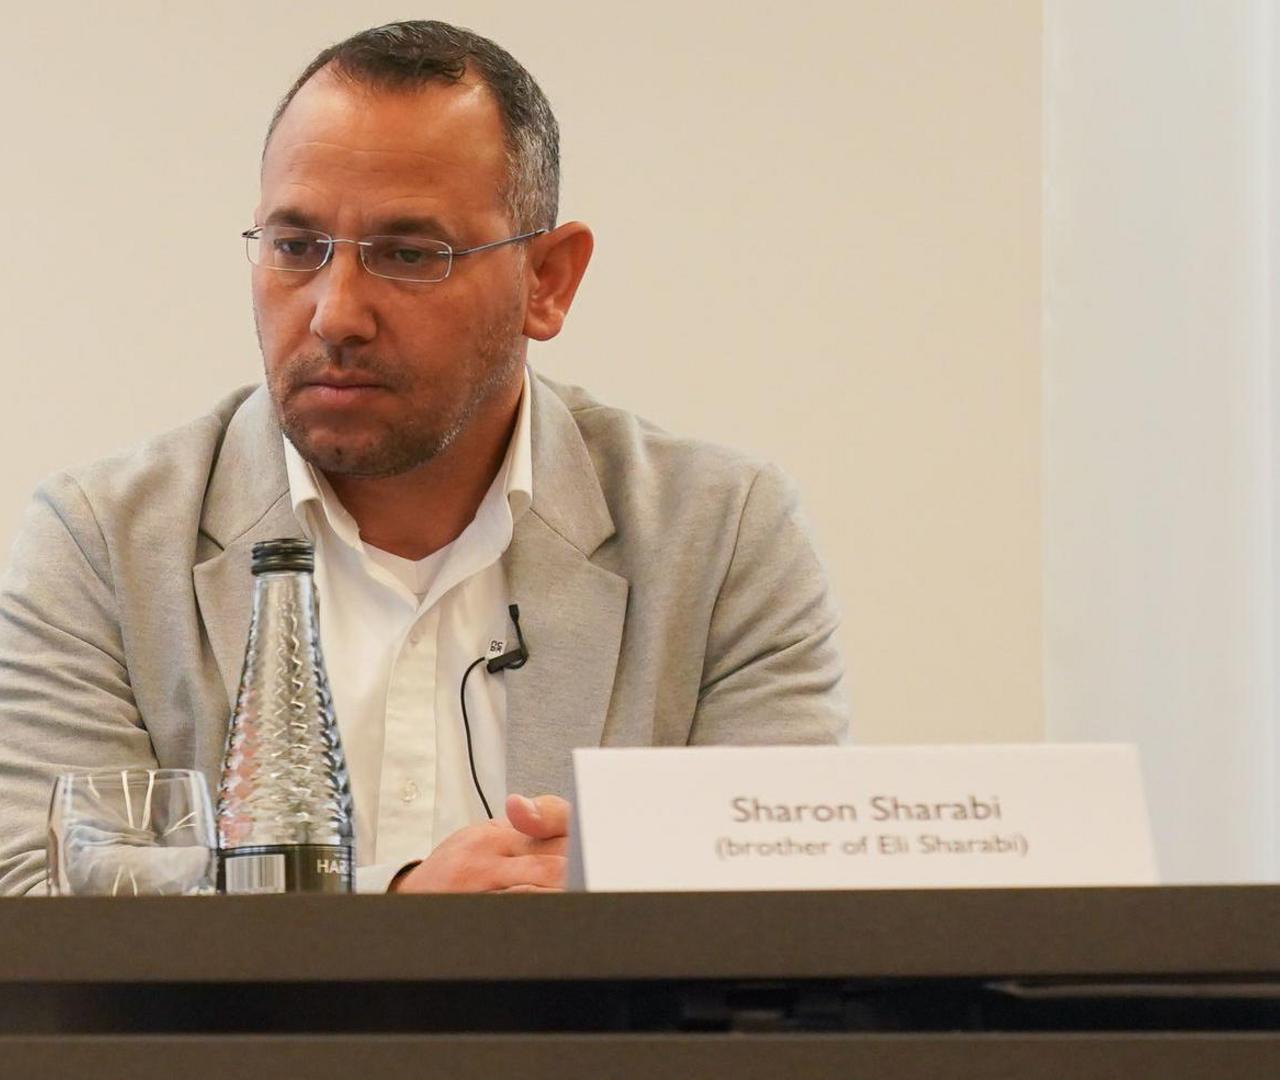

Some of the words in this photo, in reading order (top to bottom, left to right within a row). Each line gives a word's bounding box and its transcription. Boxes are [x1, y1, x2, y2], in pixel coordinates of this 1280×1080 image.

[731, 796, 858, 823] Sharon
[869, 795, 1002, 822] Sharabi
[715, 835, 830, 860] (brother
[841, 835, 868, 856] of
[877, 834, 910, 855] Eli
[918, 832, 1029, 857] Sharabi)
